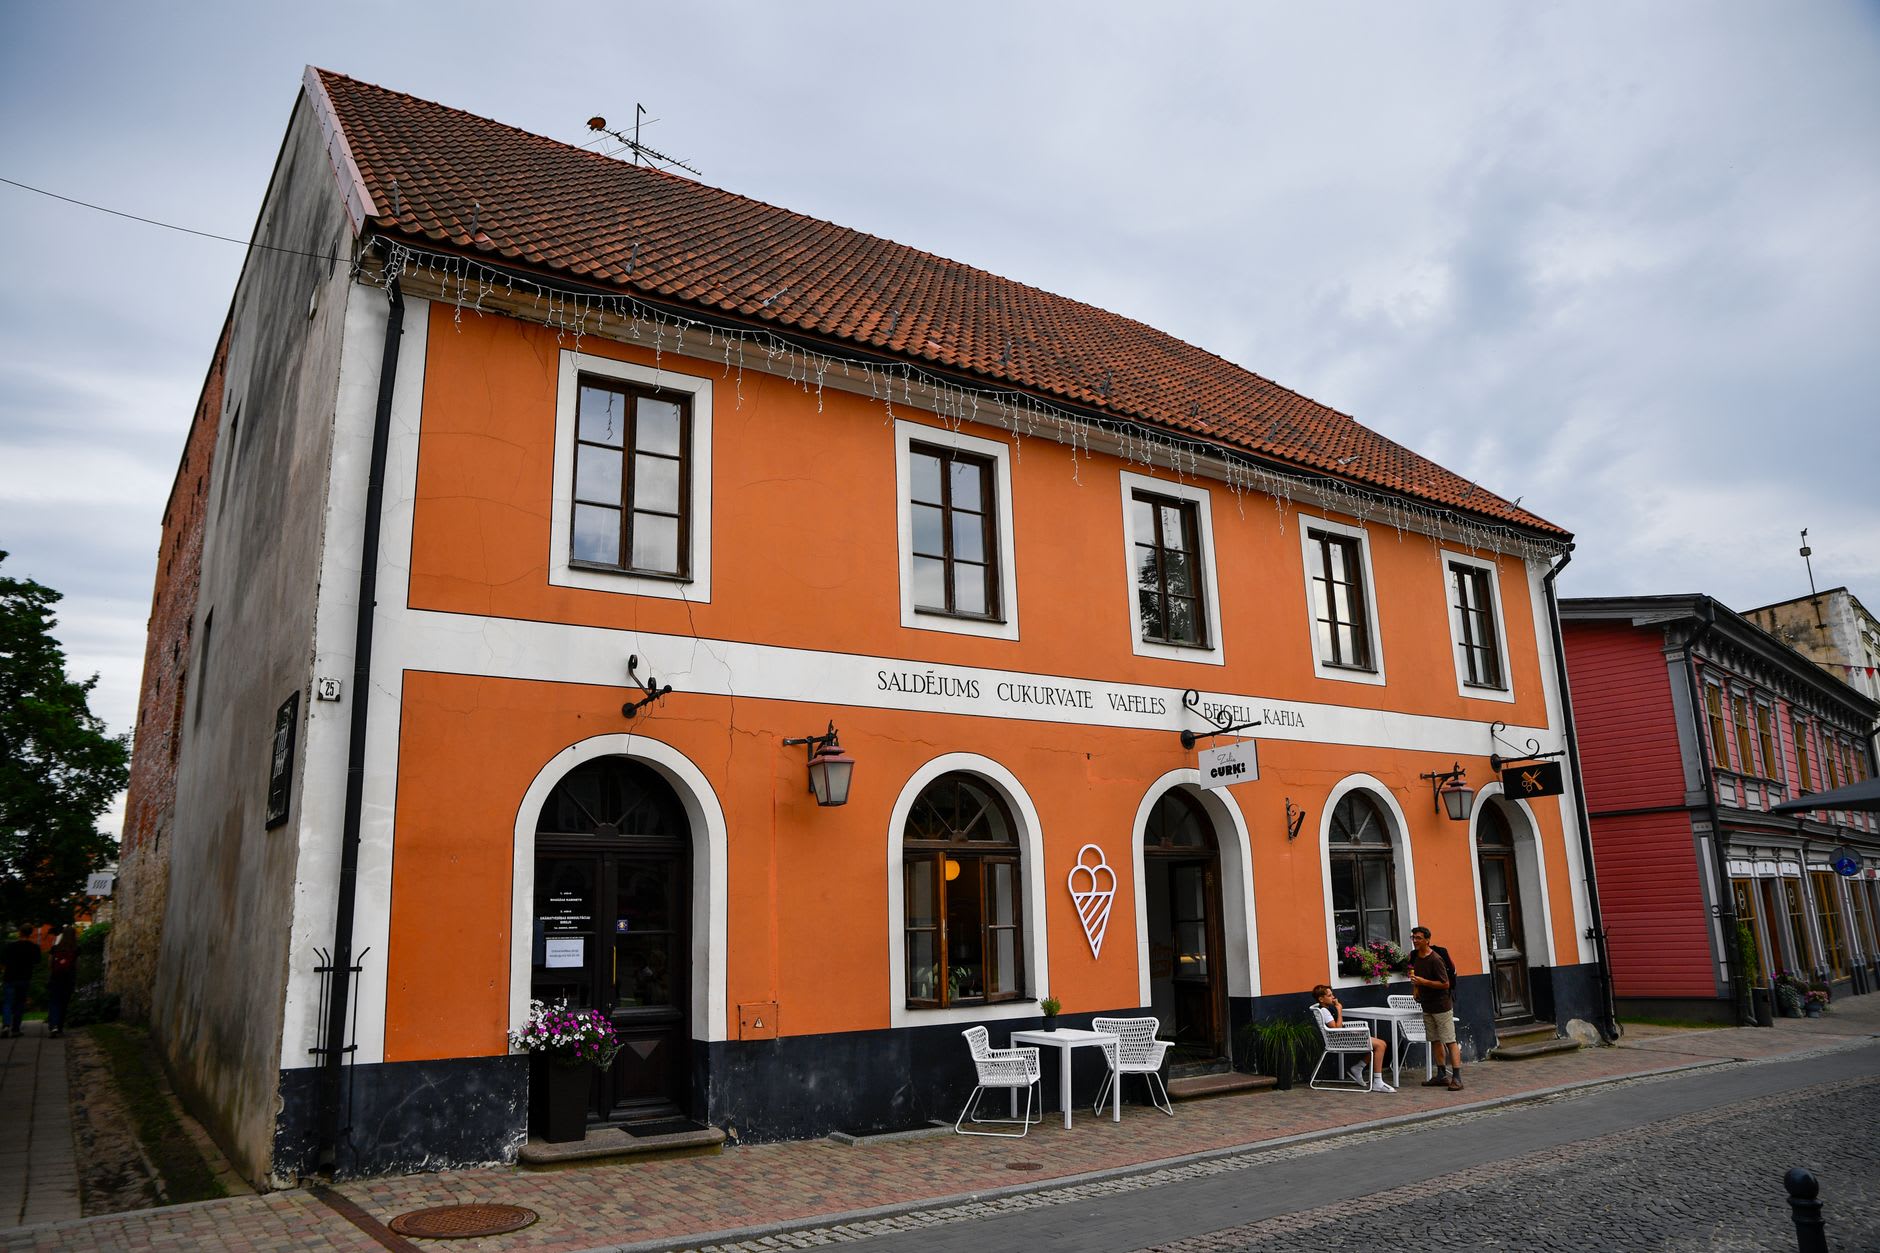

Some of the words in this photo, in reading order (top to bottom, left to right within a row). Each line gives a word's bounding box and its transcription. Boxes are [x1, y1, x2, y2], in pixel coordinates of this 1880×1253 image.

[324, 681, 335, 696] 25
[877, 670, 980, 699] SALDĒJUMS
[997, 682, 1094, 709] CUKURVATE
[1107, 692, 1167, 716] VAFELES
[1263, 708, 1305, 728] KAFIJA
